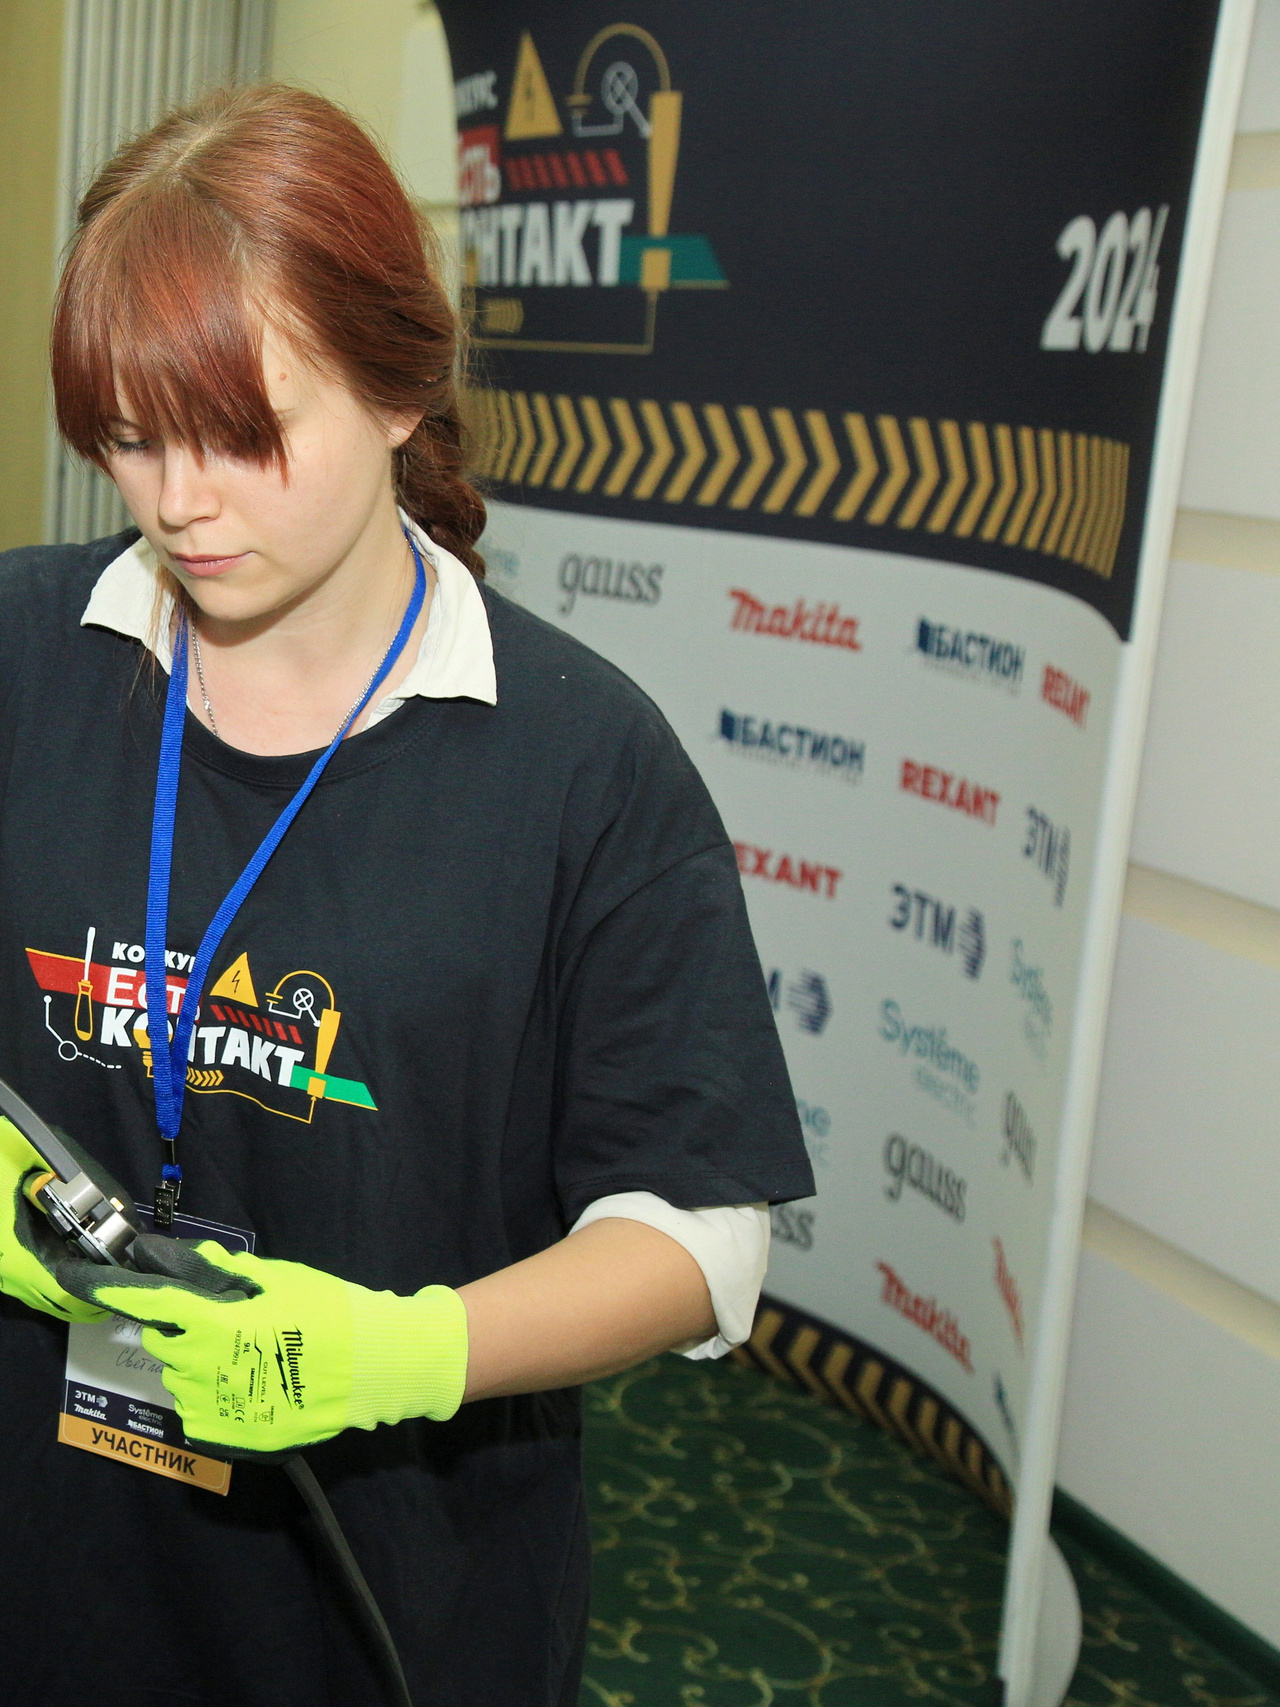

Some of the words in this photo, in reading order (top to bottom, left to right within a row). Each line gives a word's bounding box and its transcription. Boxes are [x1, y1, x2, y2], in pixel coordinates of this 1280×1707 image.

[1040, 203, 1170, 354] 2024
[559, 553, 665, 615] gauss
[741, 714, 866, 774] БАСТИОН
[901, 757, 1001, 828] REXANT
[733, 840, 844, 900] EXANT
[890, 883, 955, 955] ЭТМ
[883, 1133, 967, 1224] gauss
[74, 1389, 96, 1403] ЭТМ
[91, 1427, 198, 1476] УЧАСТНИК
[133, 1420, 164, 1436] БАСТИОН
